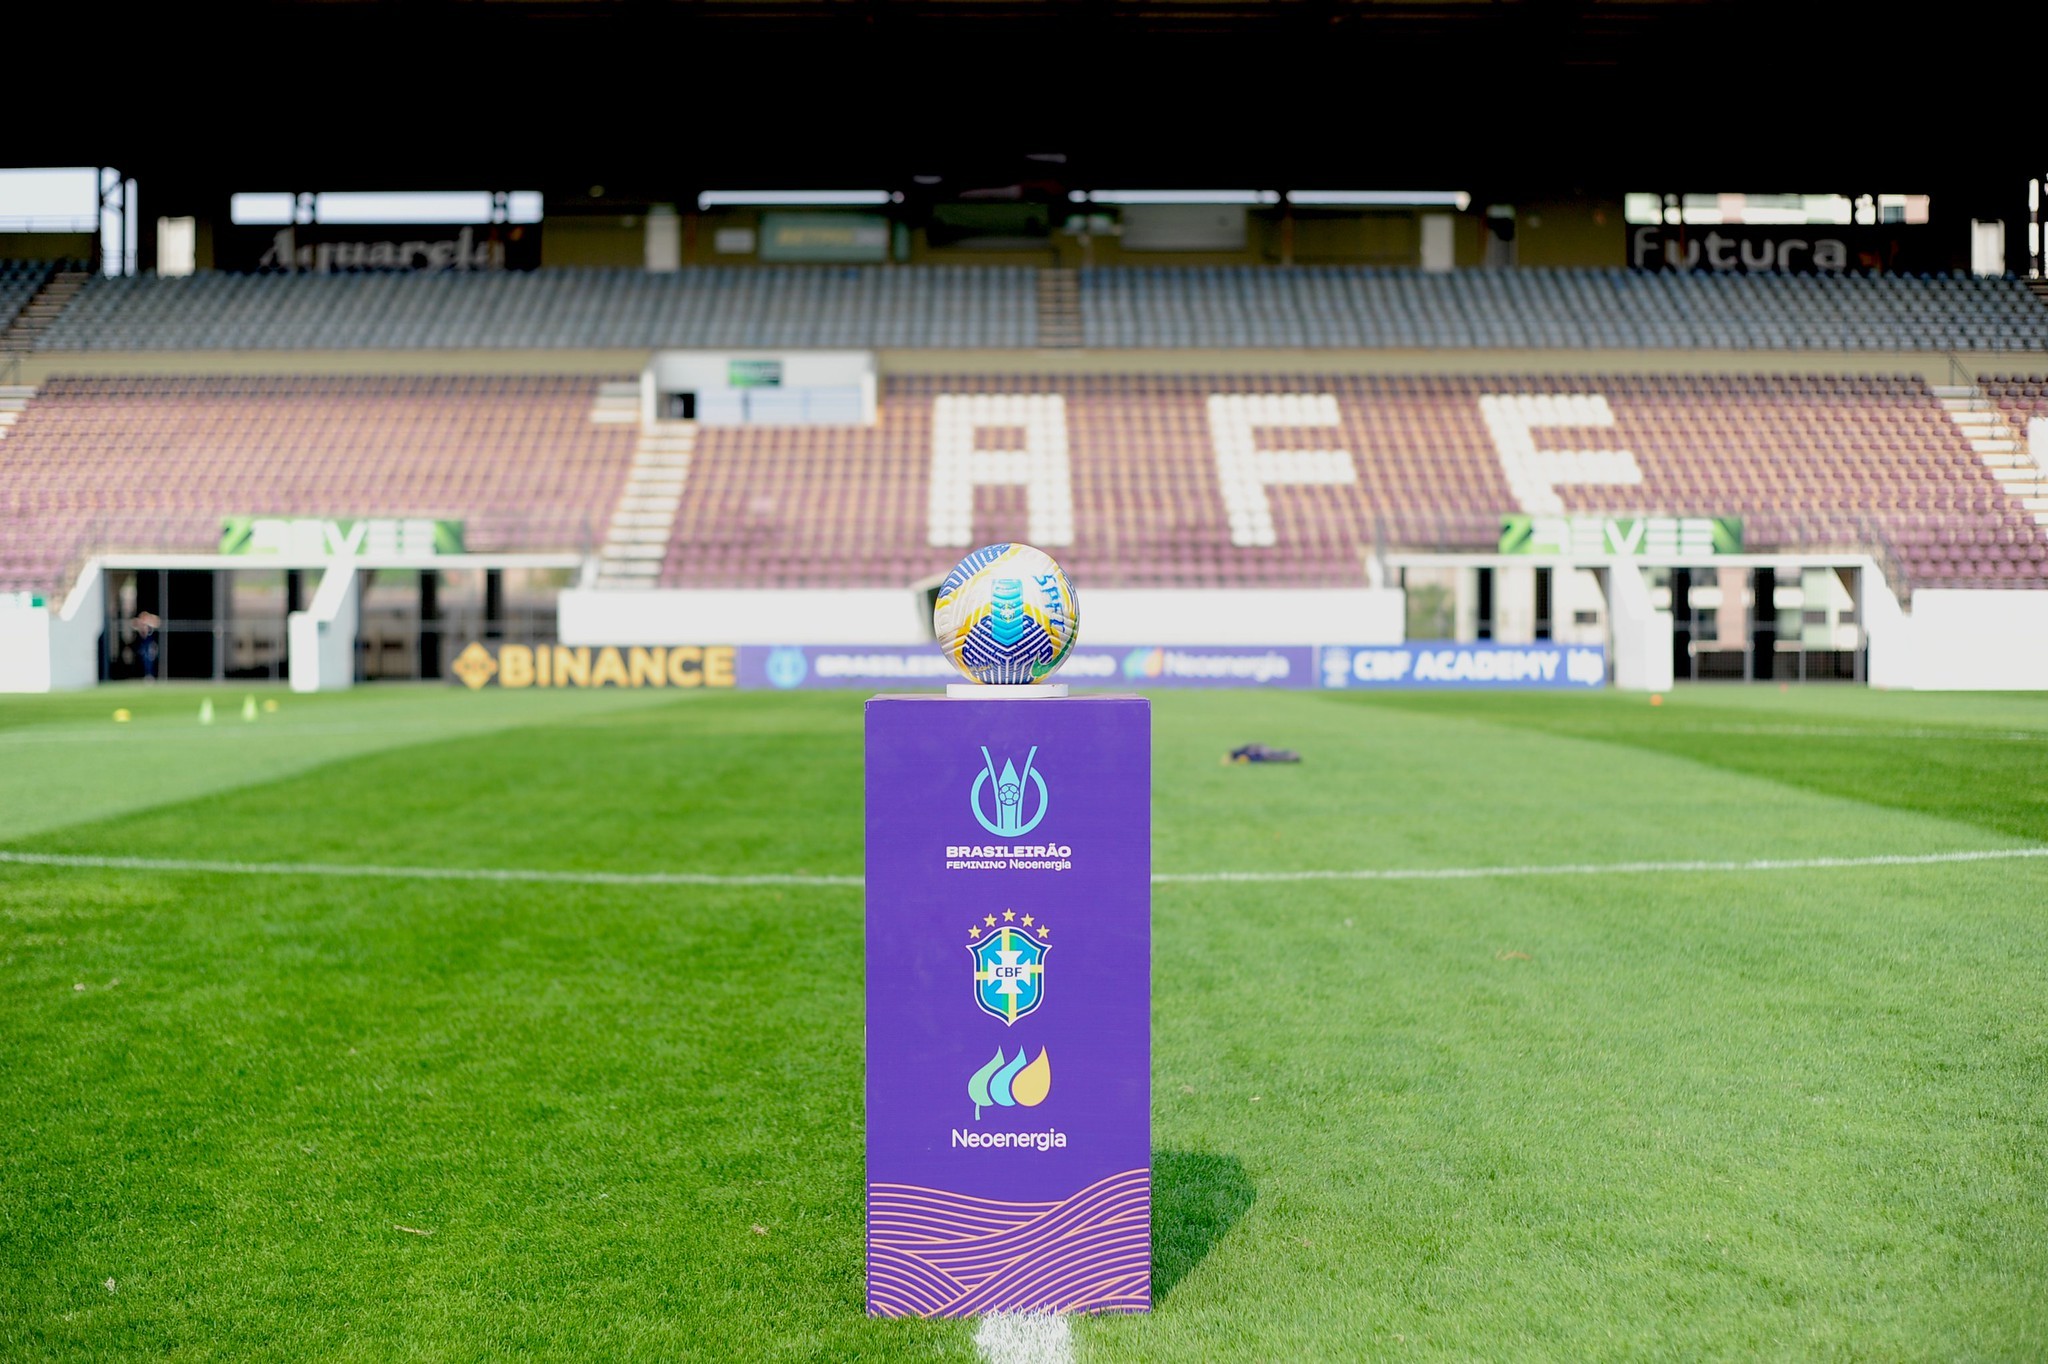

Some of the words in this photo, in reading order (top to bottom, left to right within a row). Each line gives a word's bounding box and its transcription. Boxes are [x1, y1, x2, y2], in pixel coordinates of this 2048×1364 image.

[1633, 226, 1848, 270] Futura
[501, 645, 735, 688] BINANCE
[1353, 651, 1411, 680] CBF
[1413, 651, 1560, 680] ACADEMY
[946, 843, 1071, 857] BRASILEIRÃO
[946, 860, 1007, 869] FEMININO
[1009, 858, 1071, 871] Neoenergia
[995, 966, 1022, 978] CBF
[952, 1129, 1067, 1151] Neoenergia
